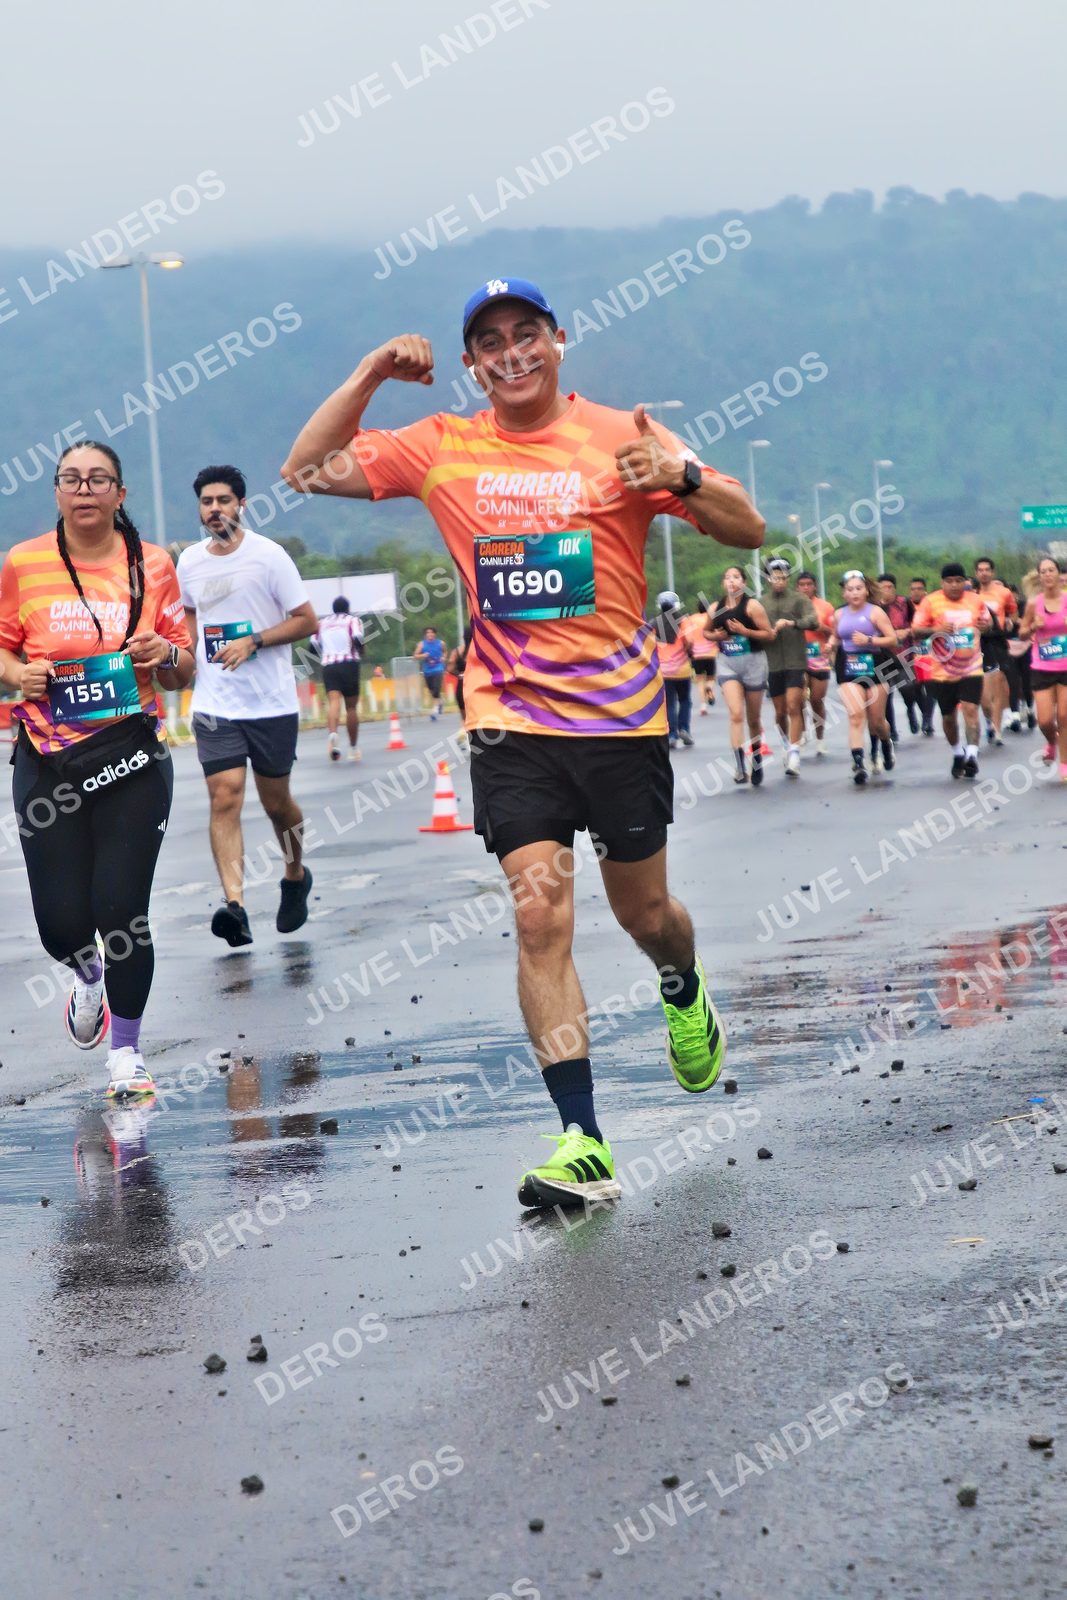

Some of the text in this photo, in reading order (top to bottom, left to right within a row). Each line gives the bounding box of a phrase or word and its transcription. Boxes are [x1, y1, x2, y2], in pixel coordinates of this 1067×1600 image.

[476, 471, 581, 496] CARRERA
[480, 538, 580, 556] CARRERA 10K
[492, 569, 563, 596] 1690
[108, 656, 125, 670] 10K
[64, 680, 116, 704] 1551
[82, 750, 150, 792] adidas
